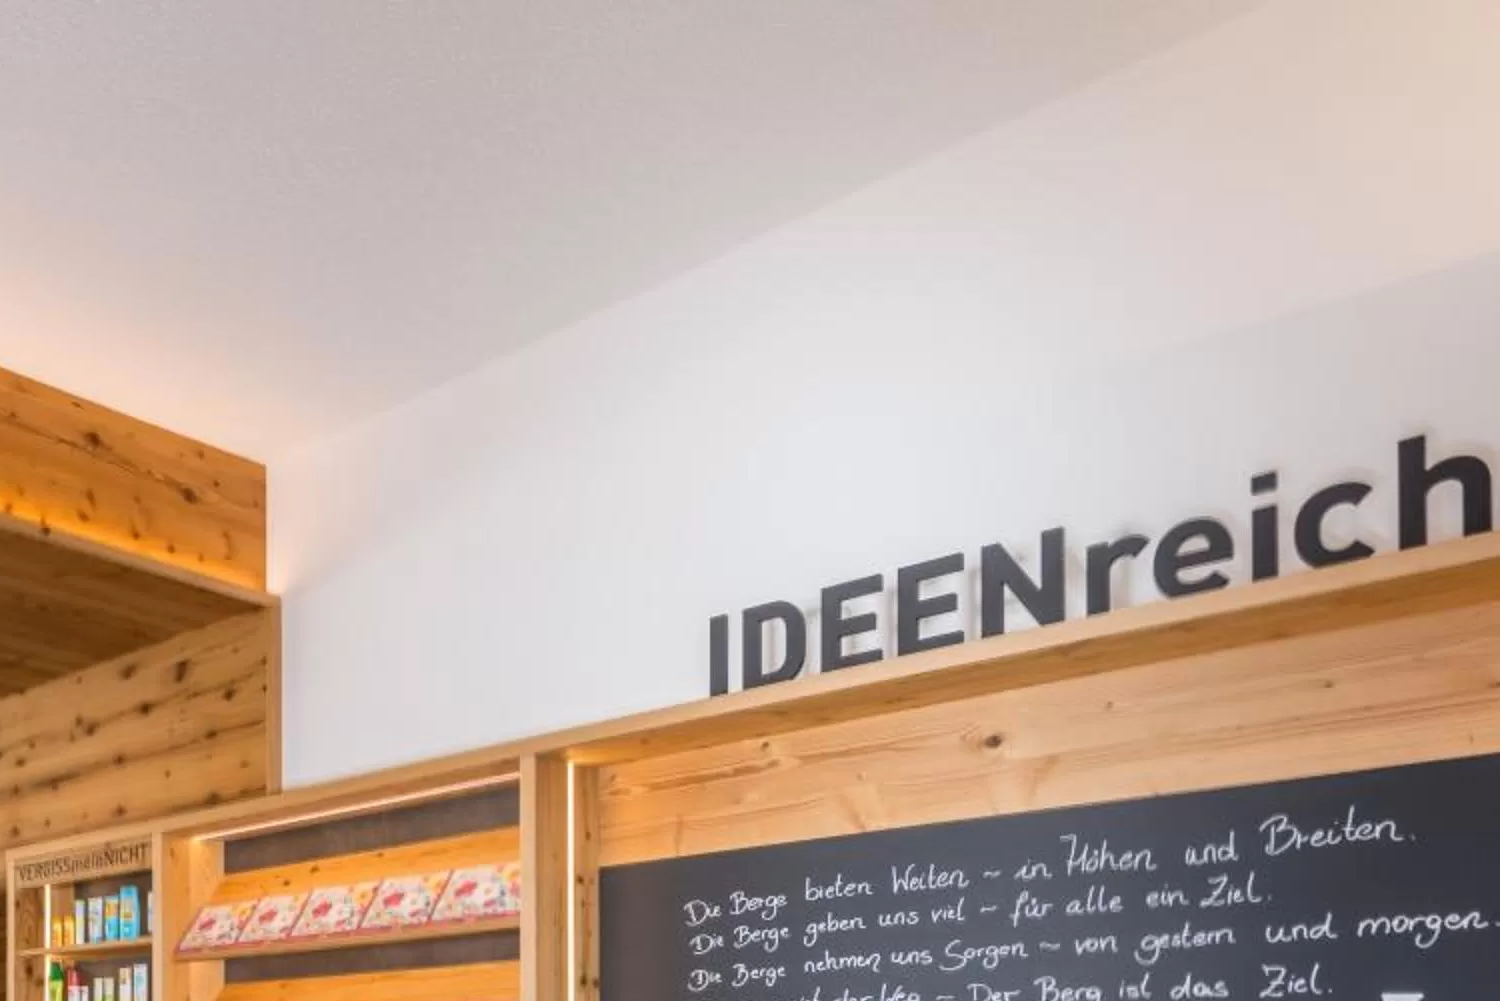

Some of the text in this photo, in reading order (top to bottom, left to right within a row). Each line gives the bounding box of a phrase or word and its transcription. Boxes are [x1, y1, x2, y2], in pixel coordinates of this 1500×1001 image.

[709, 434, 1493, 698] IDEENreich
[684, 899, 722, 926] Die
[730, 891, 788, 920] Berge
[804, 873, 873, 900] bieten
[892, 863, 970, 894] Weiten
[1014, 859, 1052, 880] in
[1059, 833, 1157, 876] Höhen
[1185, 828, 1239, 866] und
[1259, 804, 1416, 856] Breiten.
[687, 969, 723, 992] Die
[731, 963, 787, 988] Berge
[803, 950, 880, 974] nehmen
[891, 949, 933, 966] uns
[938, 939, 1029, 971] Sorgen
[1074, 935, 1118, 956] von
[1134, 920, 1237, 966] gestern
[1264, 911, 1338, 944] und
[689, 933, 724, 955] Die
[733, 925, 790, 953] Berge
[803, 912, 866, 947] geben
[878, 910, 919, 927] uns
[931, 897, 965, 923] viel
[1009, 890, 1053, 928] für
[1065, 885, 1124, 915] alle
[1146, 882, 1190, 908] ein
[1118, 972, 1151, 1000] ist
[1169, 971, 1231, 1001] das
[1258, 962, 1334, 999] Ziel.
